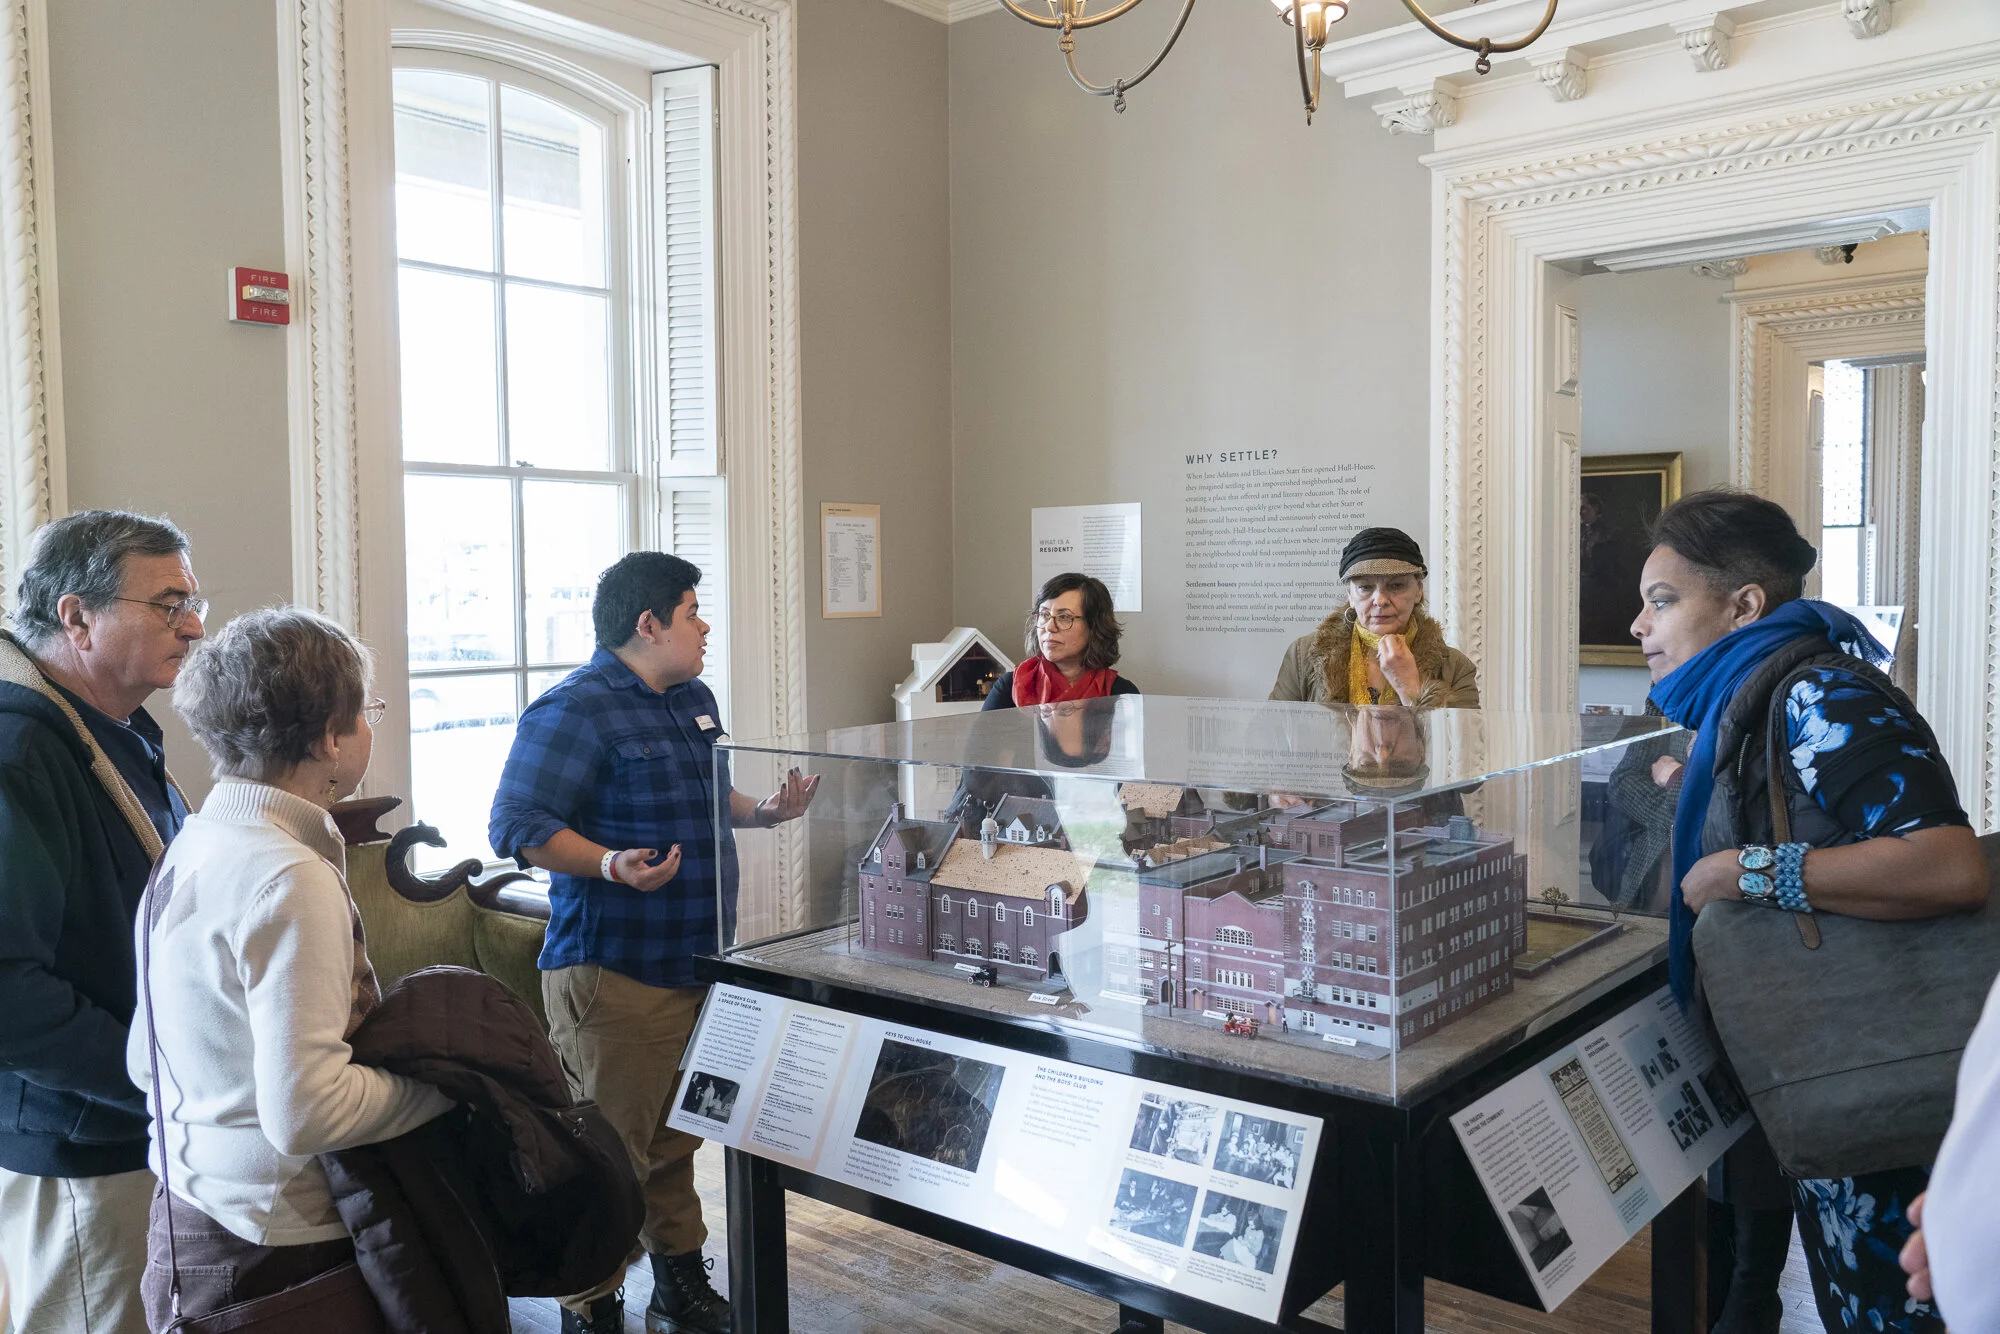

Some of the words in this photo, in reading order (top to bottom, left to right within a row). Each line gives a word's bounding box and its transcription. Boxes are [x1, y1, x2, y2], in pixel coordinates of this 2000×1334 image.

[250, 274, 276, 284] FIRE
[252, 307, 278, 316] FIRE
[1186, 454, 1213, 464] WHY
[1220, 449, 1278, 463] SETTLE?
[1204, 471, 1216, 480] Jane
[1314, 465, 1335, 475] opened
[1186, 483, 1196, 492] they
[1199, 482, 1223, 491] imagined
[1225, 481, 1245, 490] settling
[1262, 478, 1300, 489] impoverished
[1302, 477, 1343, 487] neighborhood
[1186, 495, 1207, 503] creating
[1213, 493, 1226, 502] place
[1283, 490, 1303, 500] literary
[1305, 489, 1335, 497] education.
[1246, 503, 1266, 512] quickly
[1284, 502, 1304, 511] beyond
[1240, 515, 1266, 524] imagined
[1280, 513, 1316, 523] continuously
[1186, 528, 1214, 537] expanding
[1203, 550, 1240, 559] neighborhood
[1272, 548, 1316, 558] companionship
[1186, 561, 1196, 570] they
[1238, 580, 1262, 589] provided
[1211, 592, 1229, 600] people
[1252, 614, 1281, 623] knowledge
[1206, 625, 1246, 634] interdependent
[904, 1036, 932, 1045] HULL-HOUSE
[1047, 1068, 1078, 1079] CHILDREN'S
[1078, 1075, 1104, 1086] BUILDING
